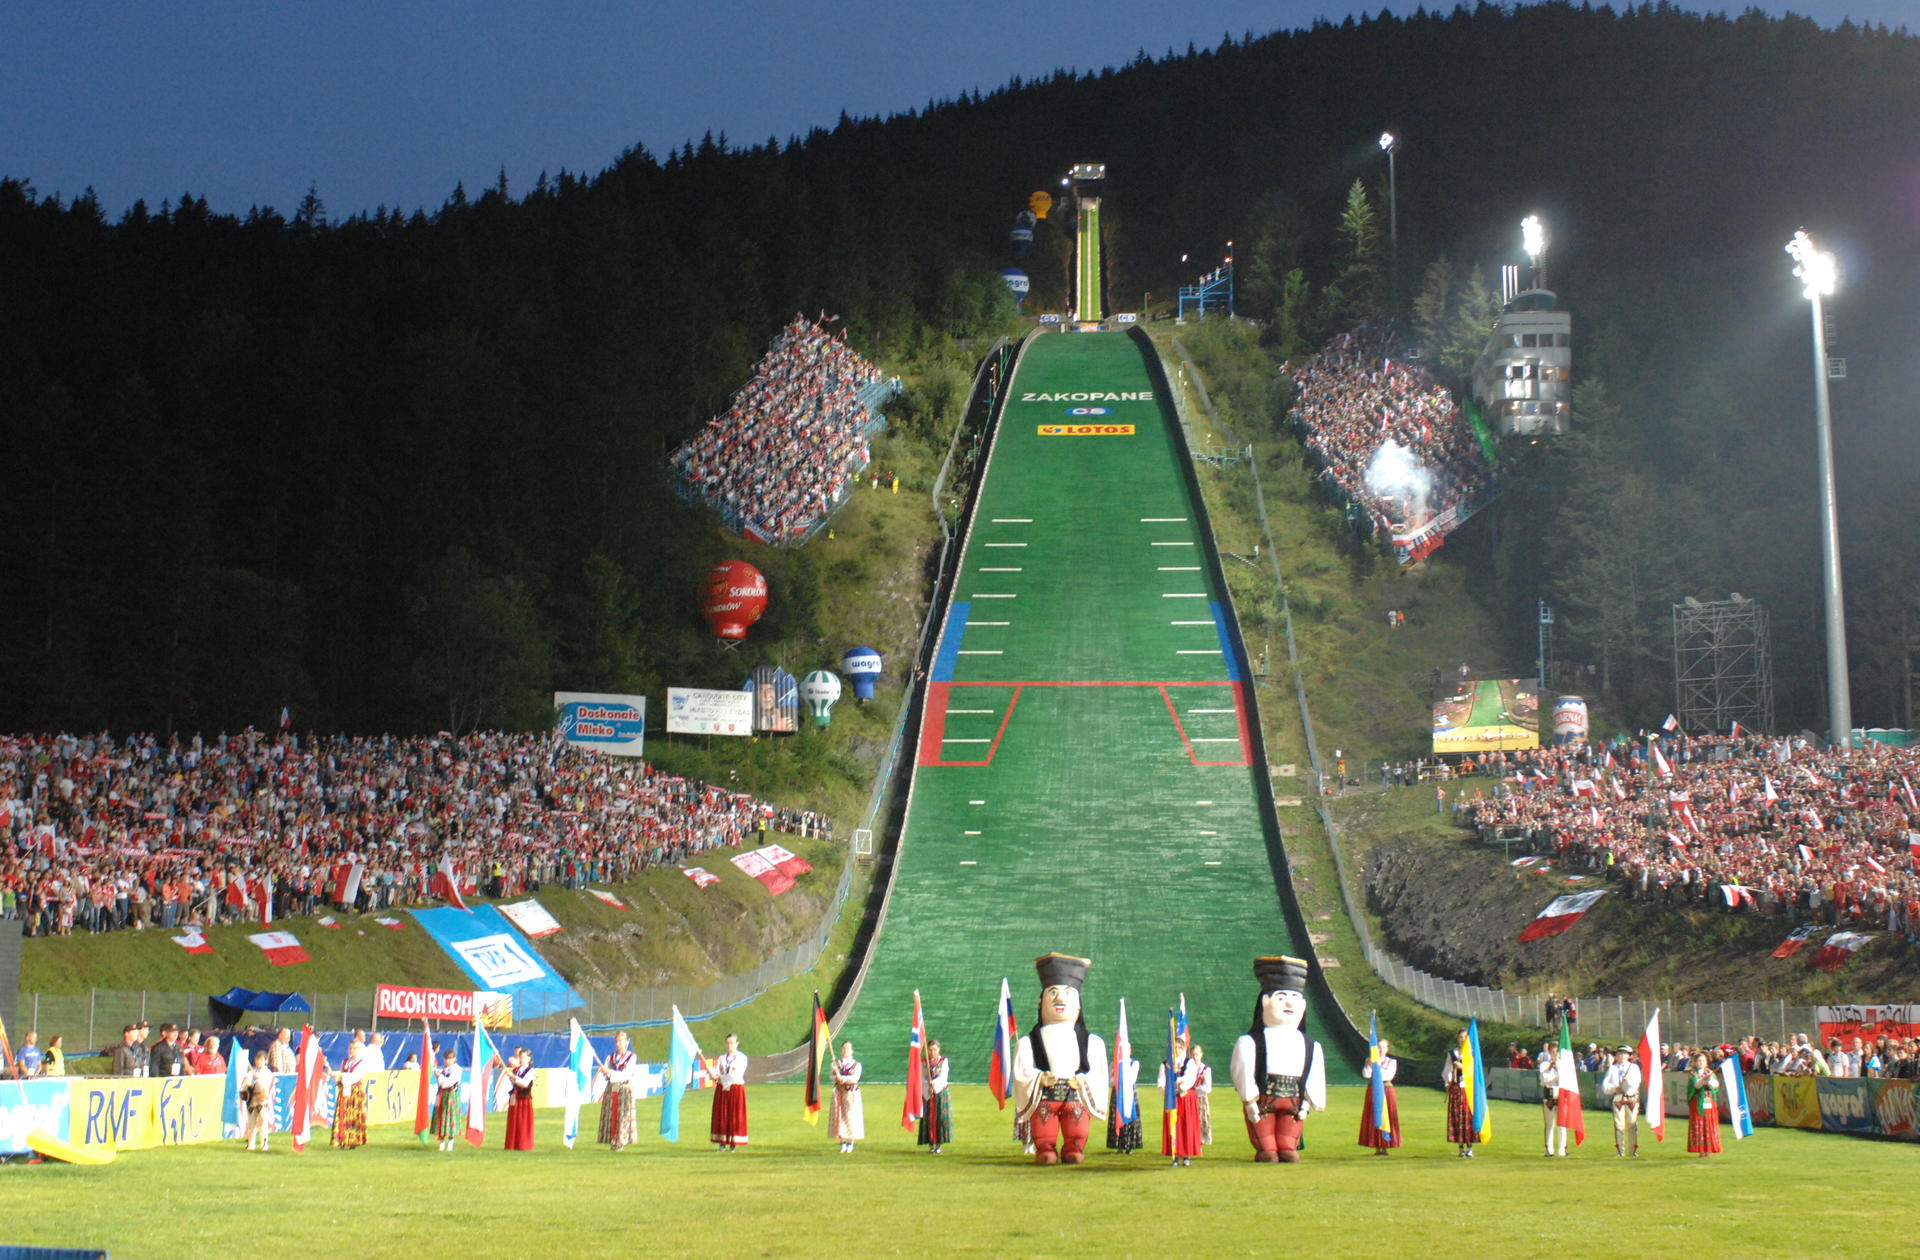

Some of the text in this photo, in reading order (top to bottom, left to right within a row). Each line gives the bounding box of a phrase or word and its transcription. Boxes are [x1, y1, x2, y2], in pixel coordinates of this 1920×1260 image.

[1021, 391, 1153, 401] ZAKOPANE
[577, 723, 614, 735] Mleko
[380, 989, 473, 1016] RICOH RICOH
[85, 1090, 143, 1144] RMF
